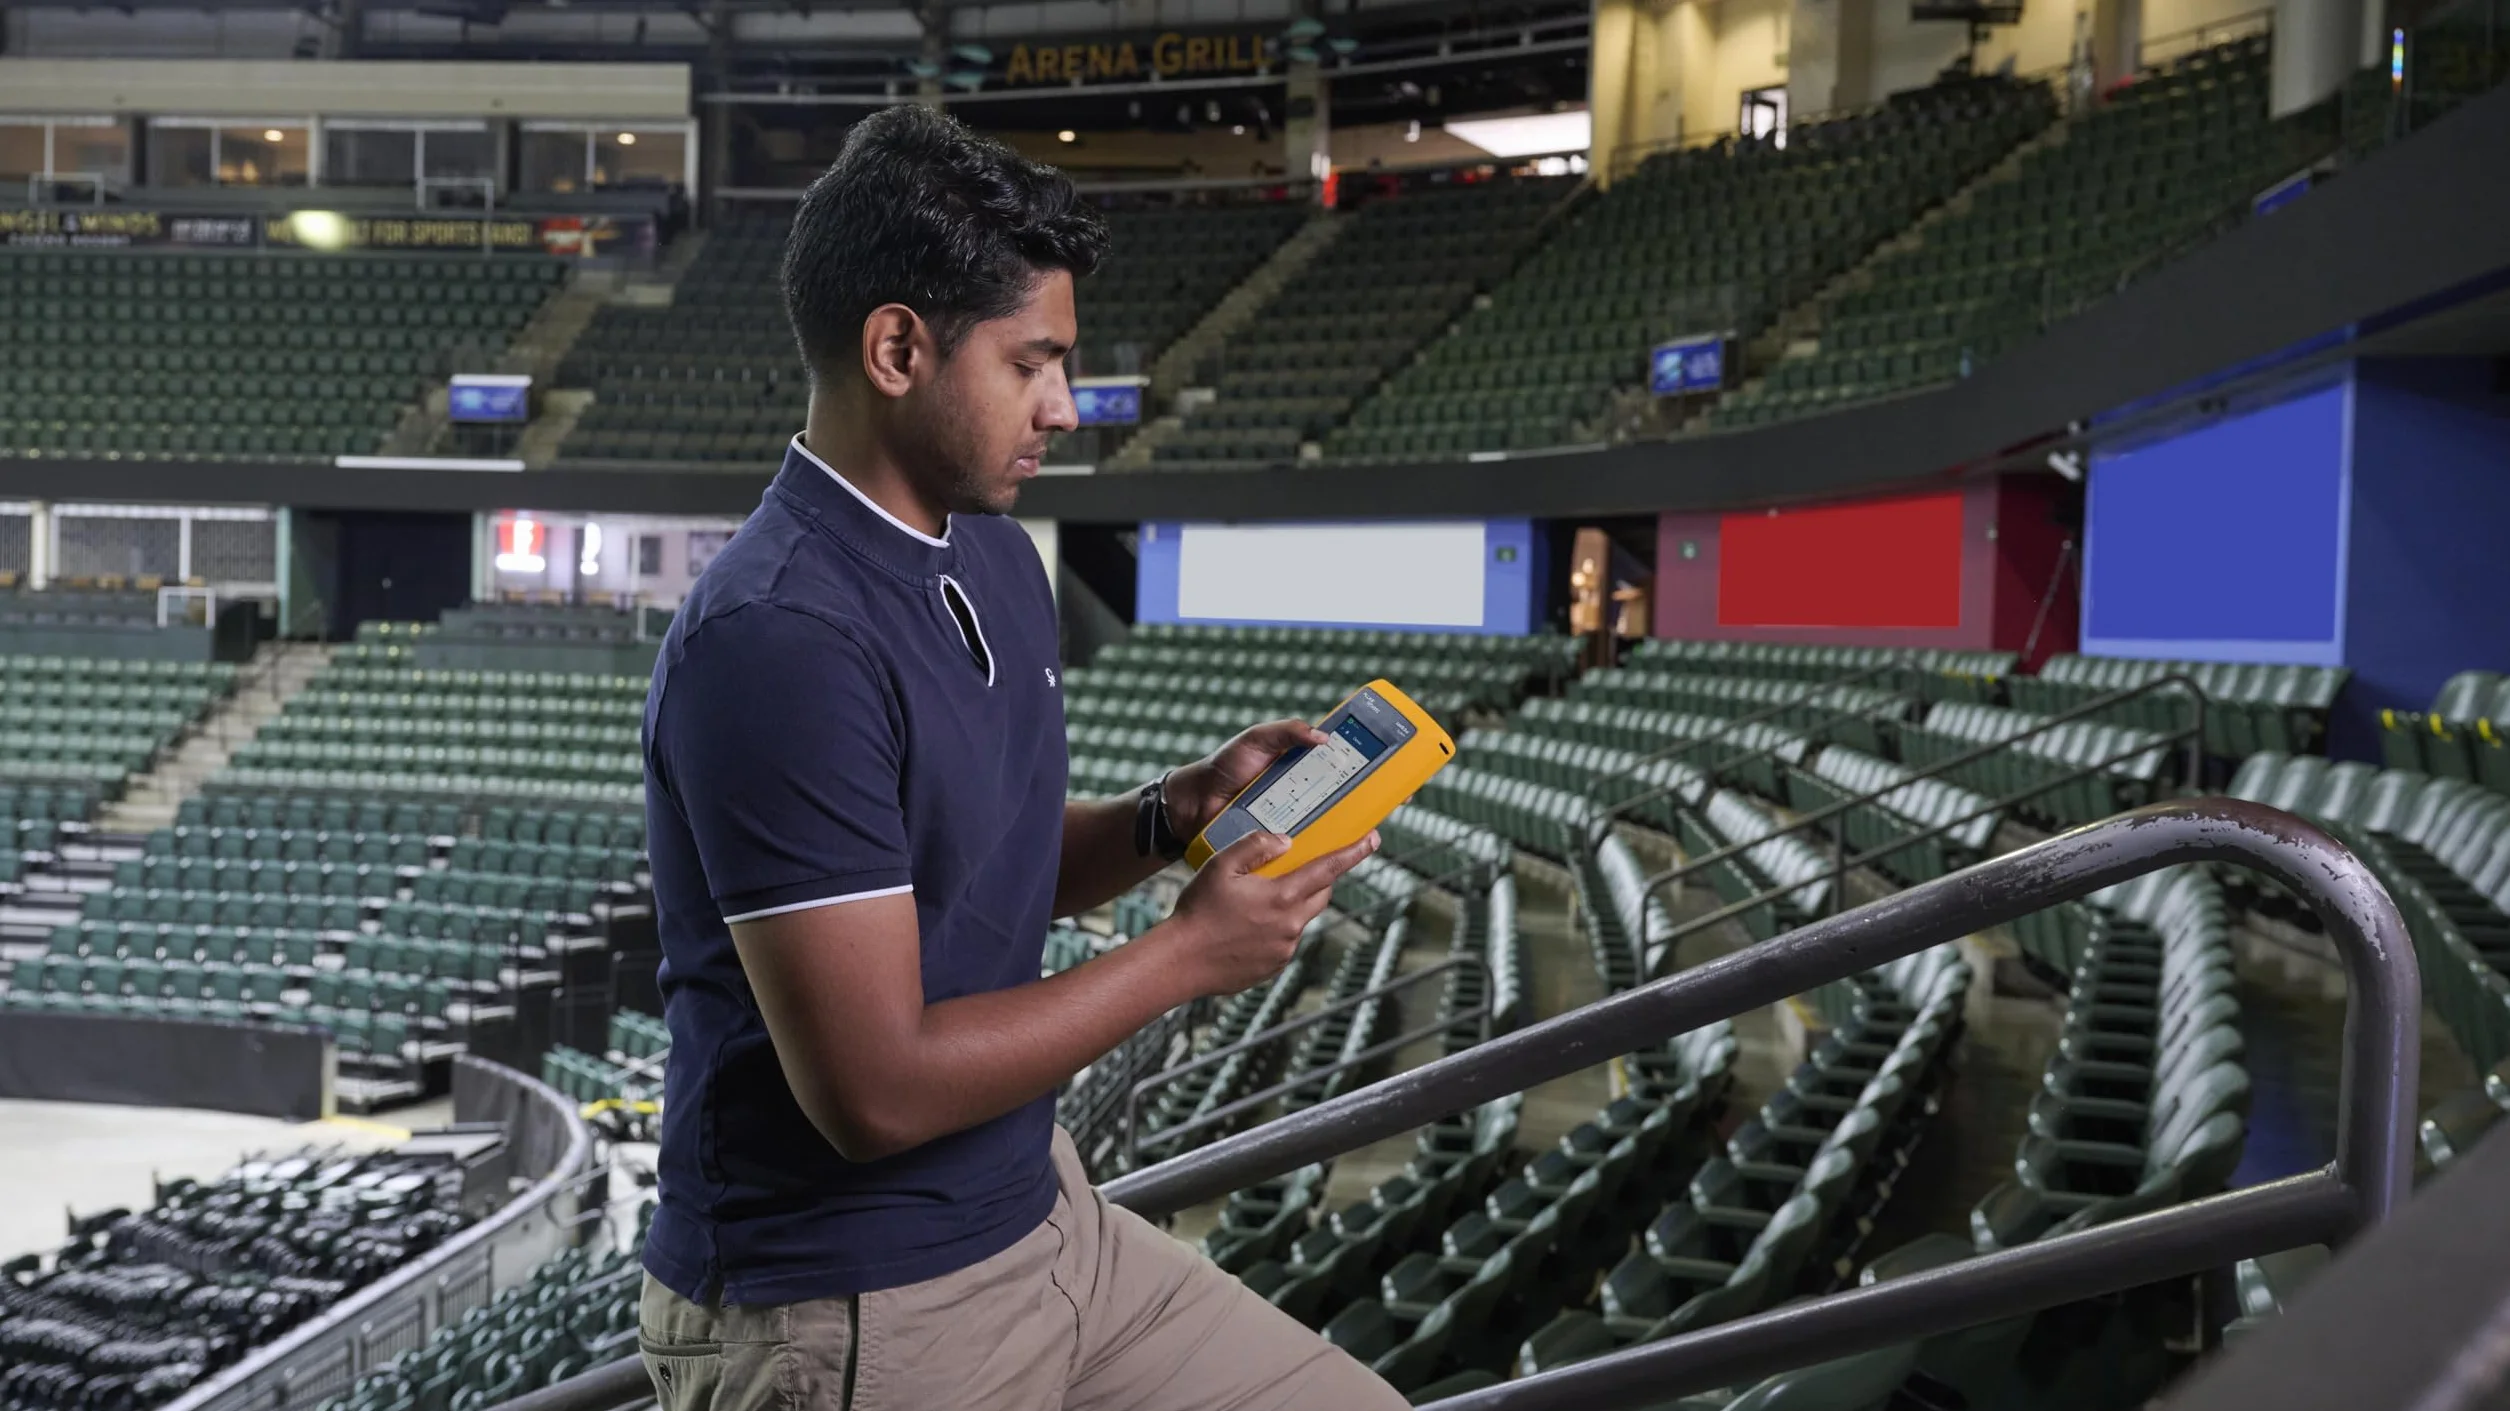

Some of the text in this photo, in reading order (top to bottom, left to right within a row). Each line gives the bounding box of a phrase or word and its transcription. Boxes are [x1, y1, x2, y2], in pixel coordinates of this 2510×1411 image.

[1006, 32, 1271, 84] ARENA GRILL
[374, 218, 403, 244] FOR
[412, 218, 478, 245] SPORTS
[485, 219, 530, 245] ANS!
